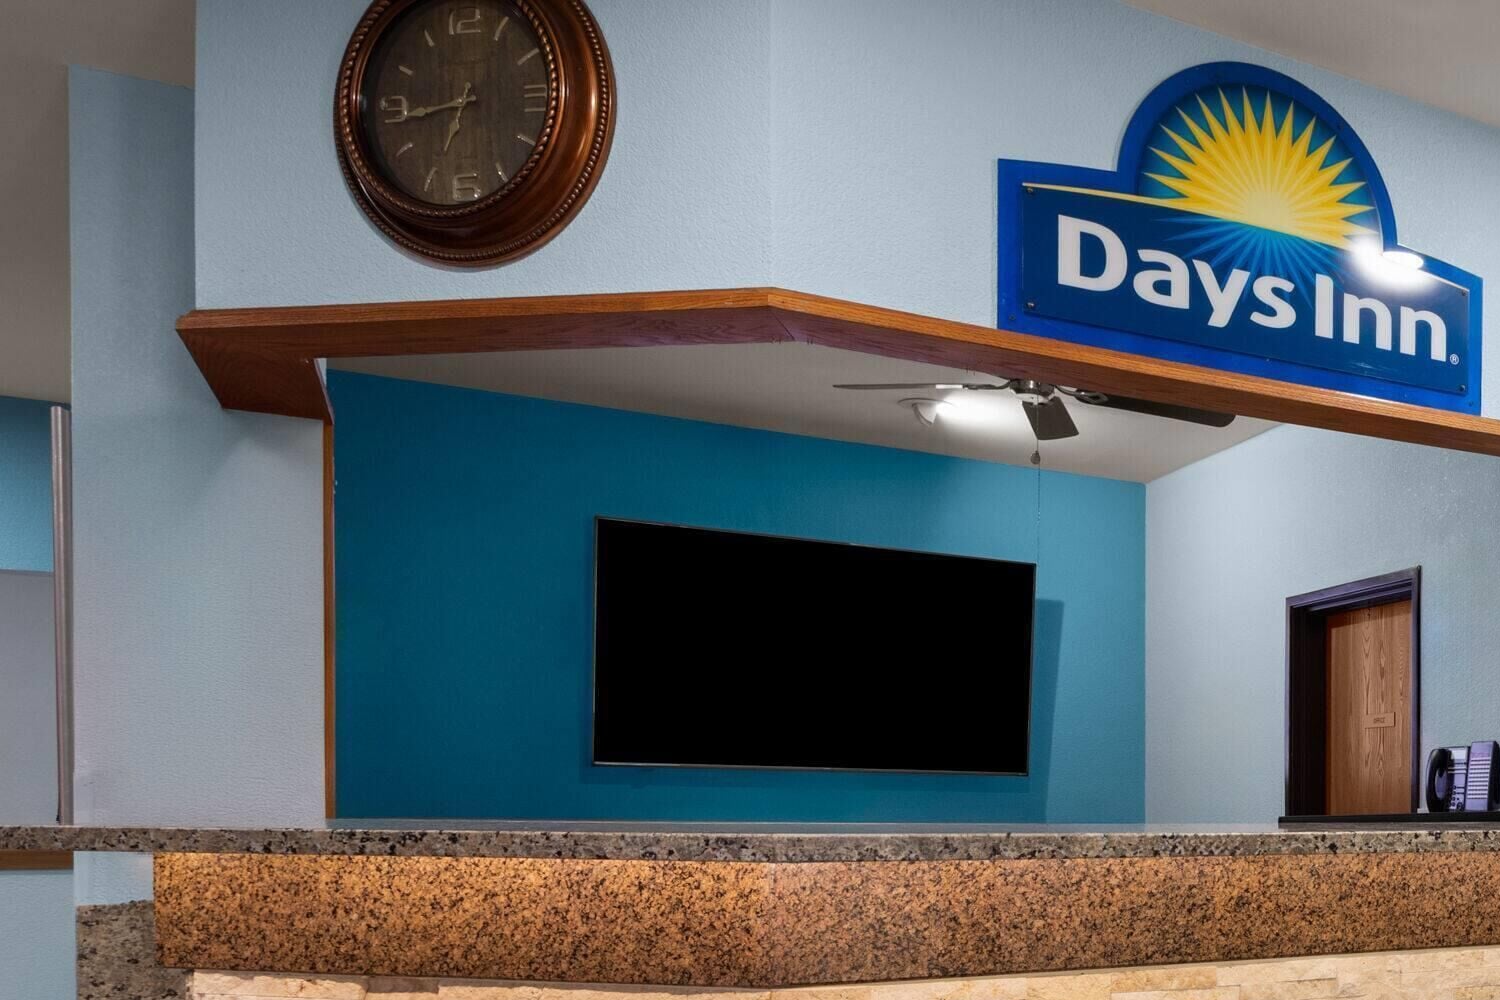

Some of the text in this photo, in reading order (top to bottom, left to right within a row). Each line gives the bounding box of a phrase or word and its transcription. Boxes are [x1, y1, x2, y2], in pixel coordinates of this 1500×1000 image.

[448, 6, 482, 36] 12
[452, 173, 481, 201] 6
[1057, 214, 1447, 363] Days Inn
